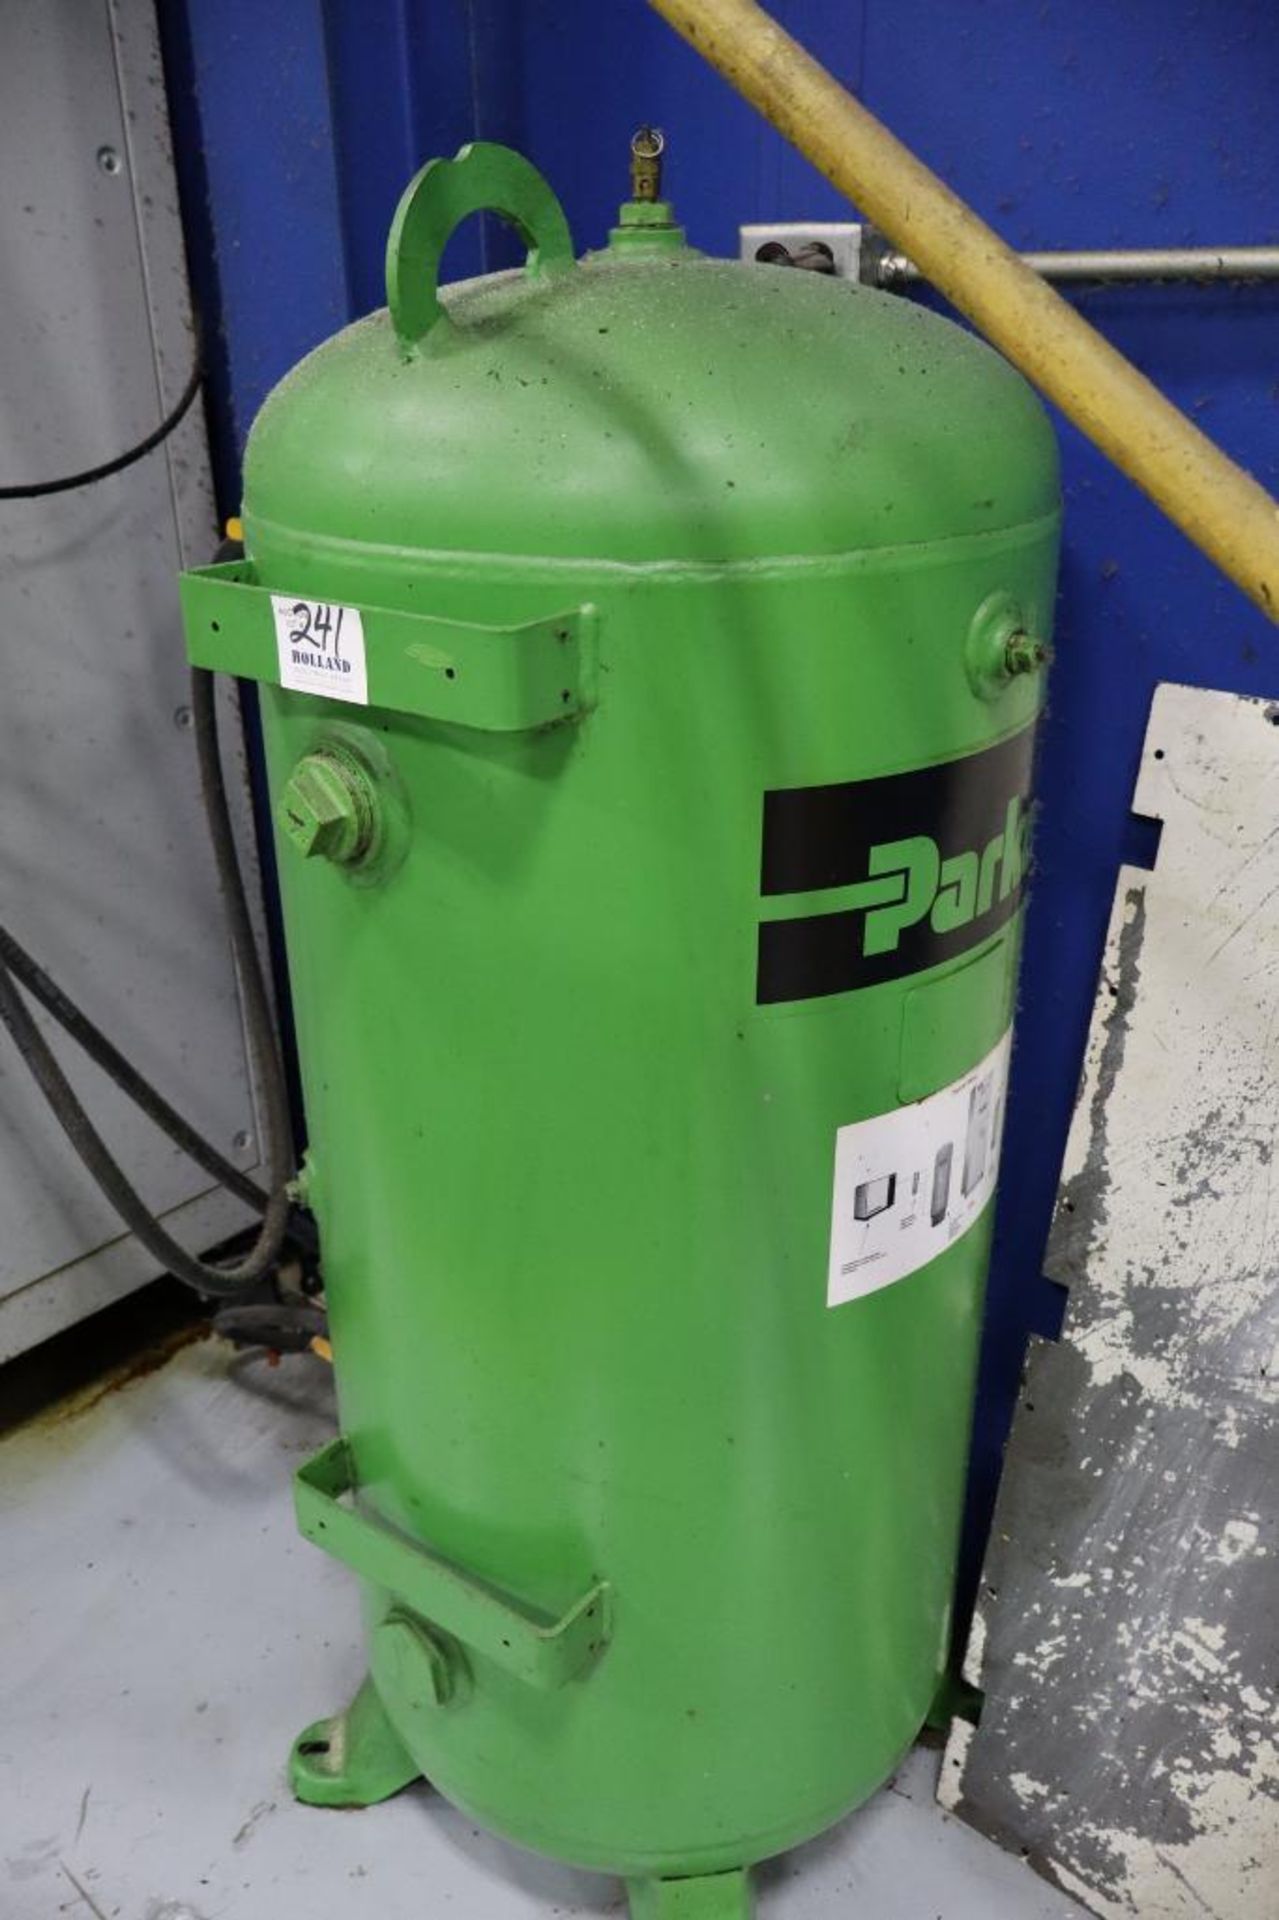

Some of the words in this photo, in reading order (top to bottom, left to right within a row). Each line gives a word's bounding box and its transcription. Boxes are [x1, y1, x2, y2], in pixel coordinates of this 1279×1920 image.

[289, 603, 343, 658] 241
[292, 649, 351, 673] HOLLAND
[863, 794, 1026, 957] Park
